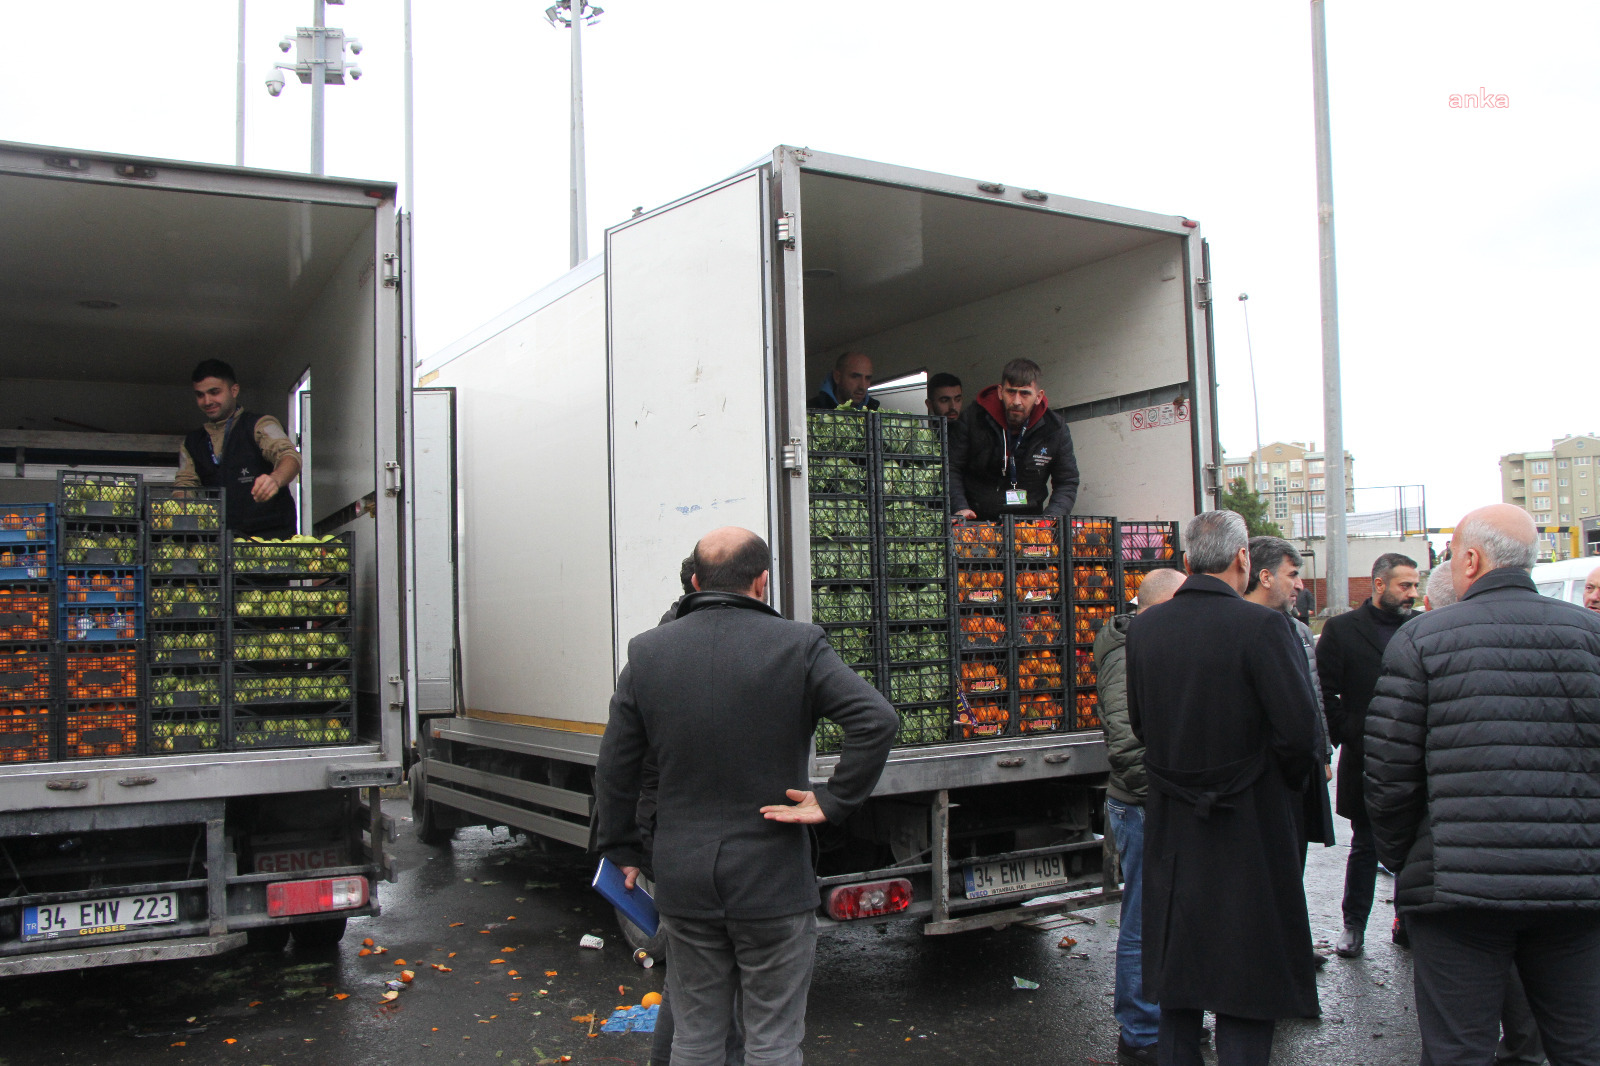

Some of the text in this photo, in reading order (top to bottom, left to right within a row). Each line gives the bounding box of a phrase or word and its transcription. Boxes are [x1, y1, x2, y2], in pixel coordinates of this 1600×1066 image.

[975, 866, 994, 888] 34
[1000, 860, 1026, 884] EMV
[1034, 856, 1061, 878] 409
[969, 889, 988, 899] IVECO
[39, 896, 172, 931] 34 EMV 223
[26, 922, 37, 930] TR
